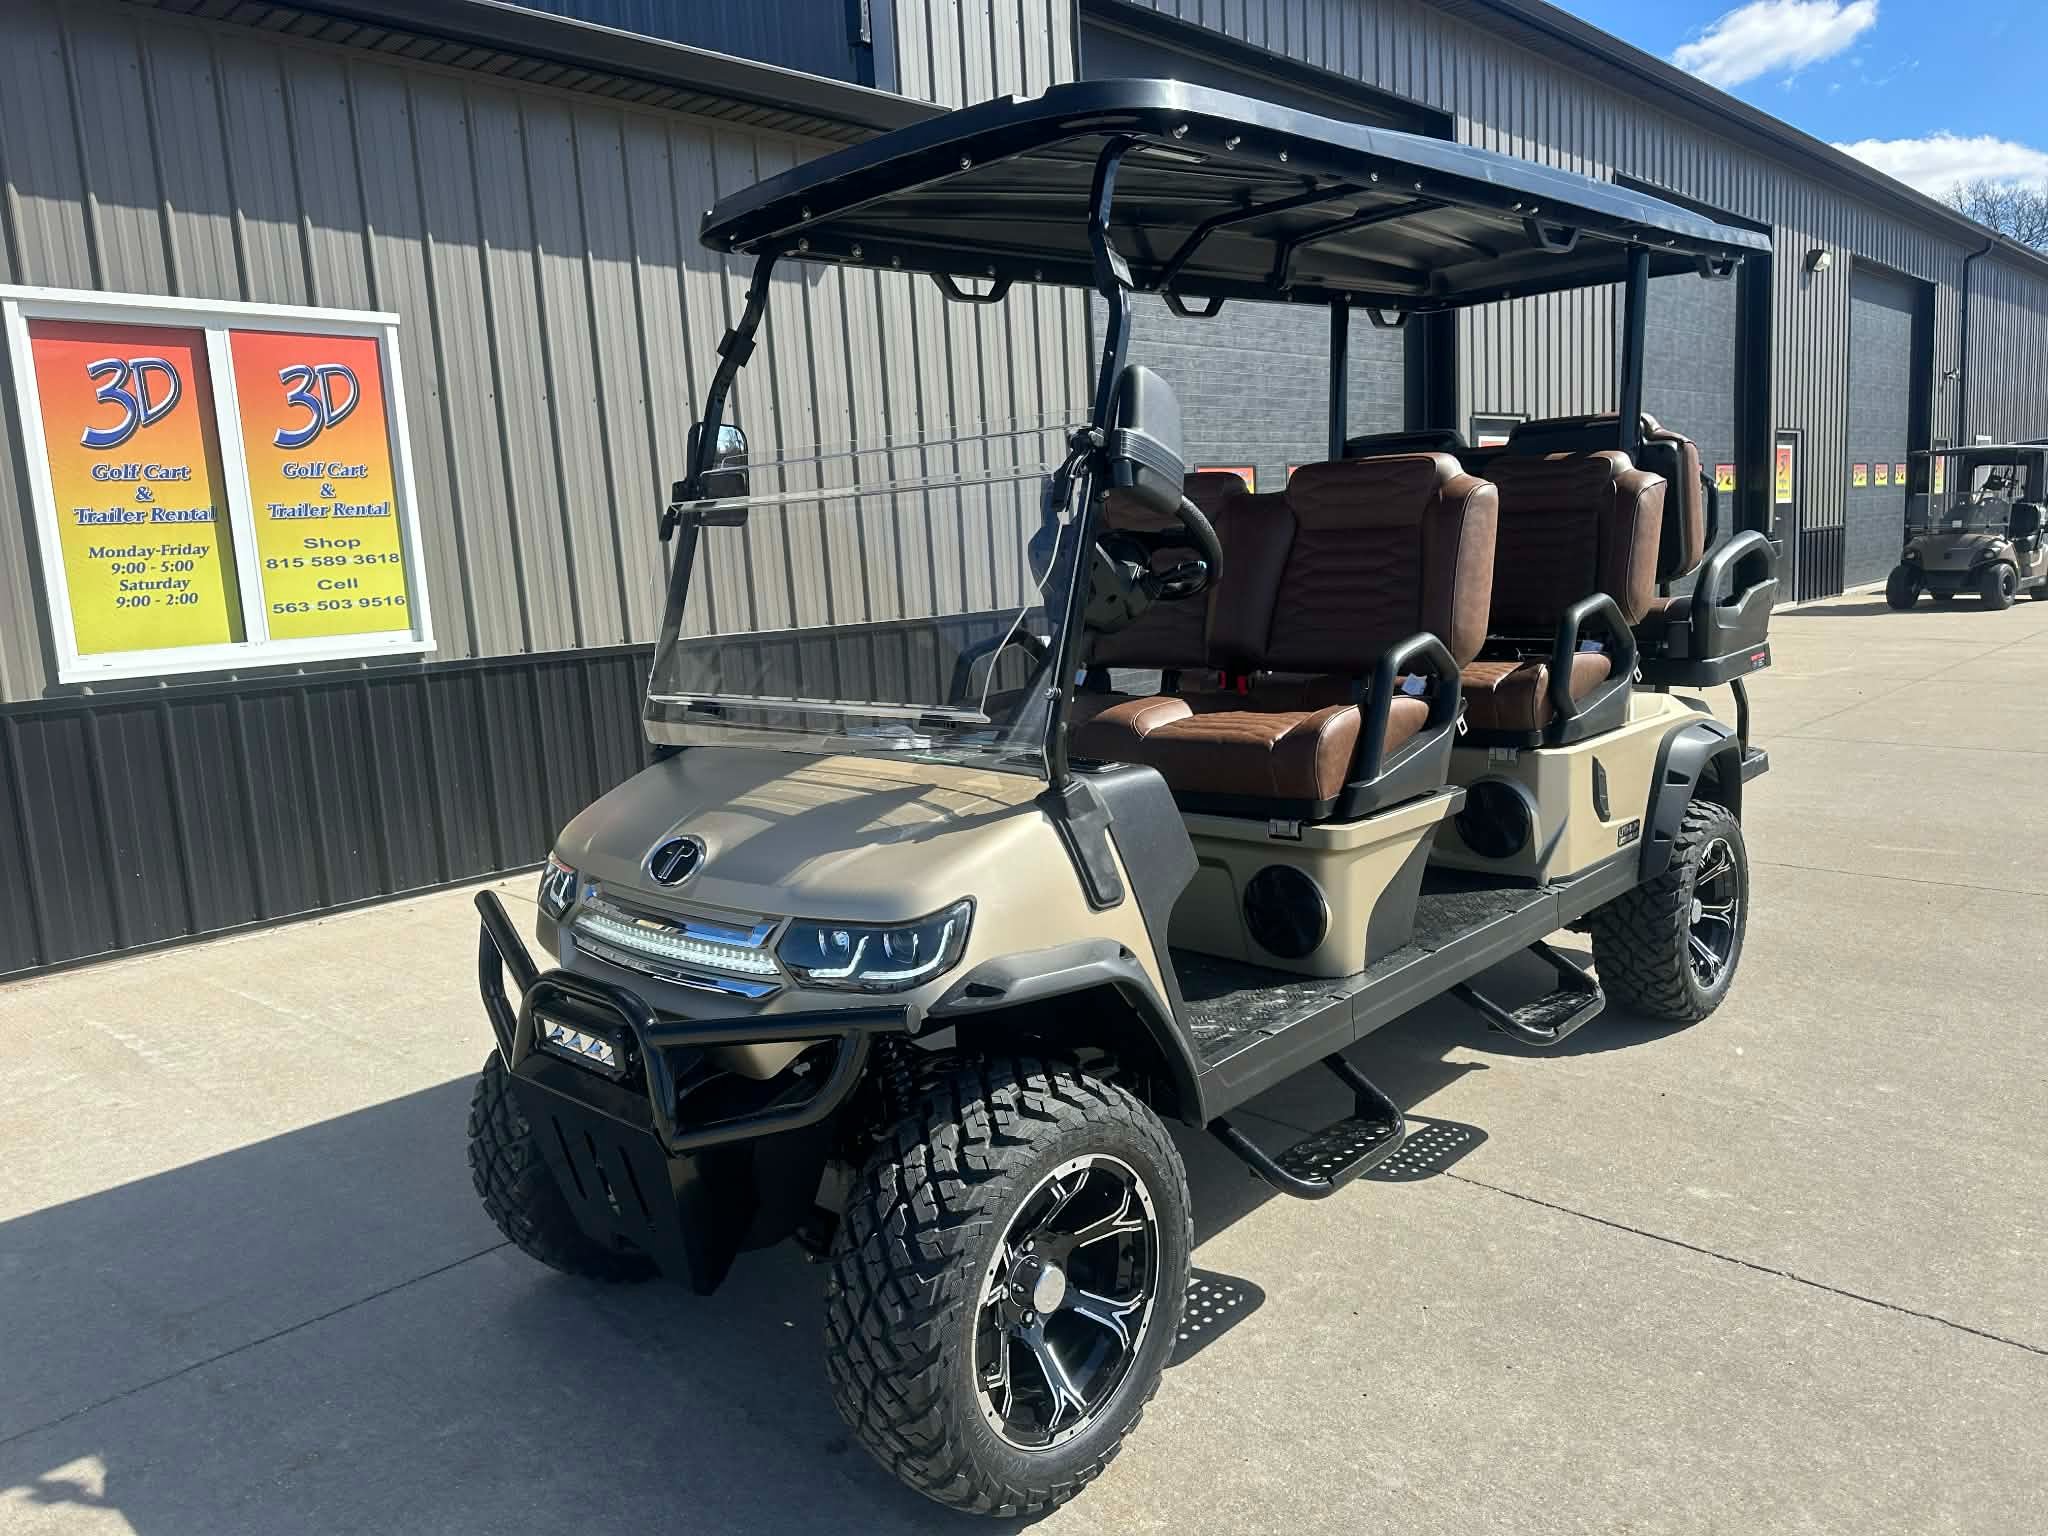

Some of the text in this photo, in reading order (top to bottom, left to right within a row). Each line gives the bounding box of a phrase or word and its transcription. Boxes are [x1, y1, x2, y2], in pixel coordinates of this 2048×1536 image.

[80, 358, 182, 450] 3D
[272, 363, 360, 450] 3D
[91, 463, 191, 482] Golf Cart
[281, 461, 368, 479] Golf Cart
[135, 486, 154, 503] &
[319, 482, 336, 498] &
[73, 505, 217, 525] Trailer Rental
[267, 501, 390, 520] Trailer Rental
[88, 543, 210, 561] Monday-Friday
[303, 538, 361, 549] Shop
[111, 562, 146, 575] 9:00
[160, 560, 194, 573] 5:00
[265, 553, 400, 569] 815 589 3618
[119, 577, 191, 592] Saturday
[317, 577, 359, 590] Cell
[116, 595, 151, 608] 9:00
[166, 592, 199, 606] 2:00
[272, 595, 406, 614] 563 503 9516
